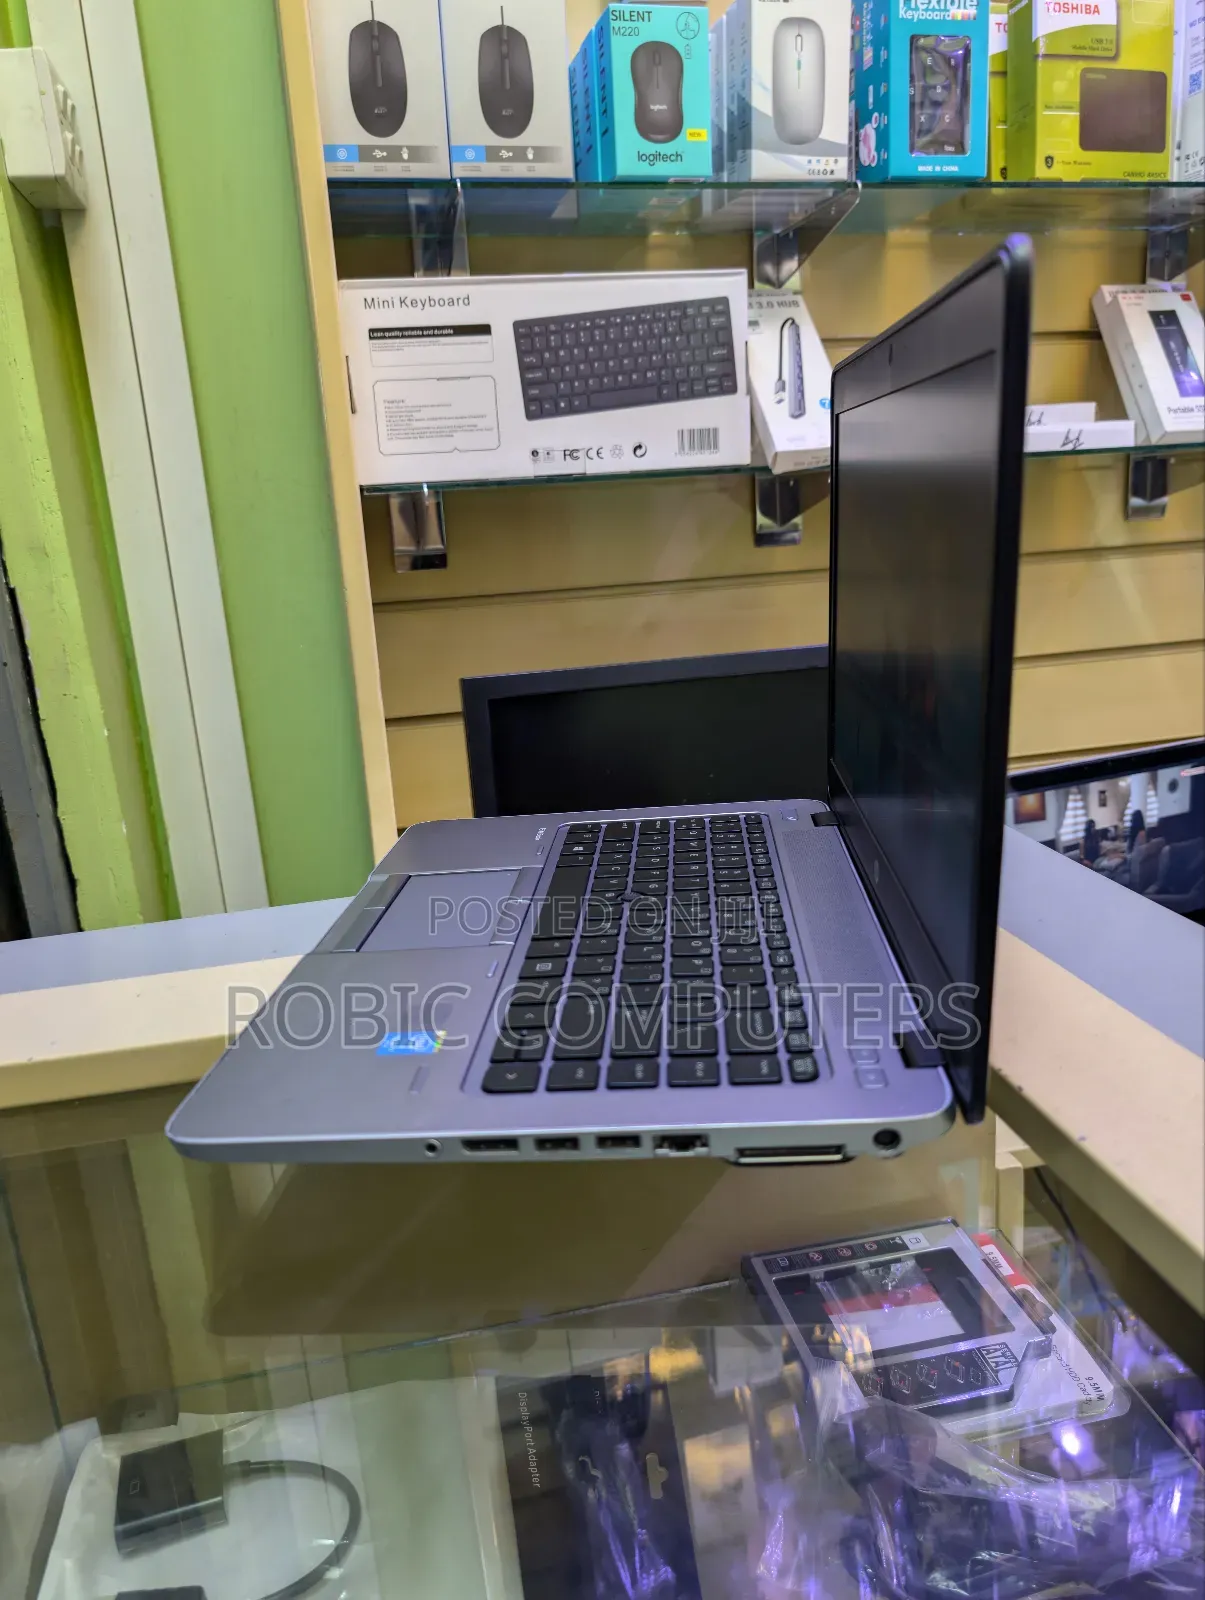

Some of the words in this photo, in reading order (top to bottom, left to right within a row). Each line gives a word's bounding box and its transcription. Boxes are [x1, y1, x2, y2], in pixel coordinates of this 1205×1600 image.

[611, 9, 652, 22] SILENT
[898, 7, 952, 21] Keyboard
[1045, 2, 1101, 15] TOSHIBA
[612, 26, 640, 37] M220
[637, 150, 683, 167] logitech
[364, 296, 395, 310] Mini
[400, 294, 471, 311] Keyboard
[980, 1345, 1012, 1370] ATA
[1085, 1376, 1105, 1402] 9.5MM
[518, 1392, 534, 1447] DisplayPort
[527, 1447, 541, 1488] Adapter
